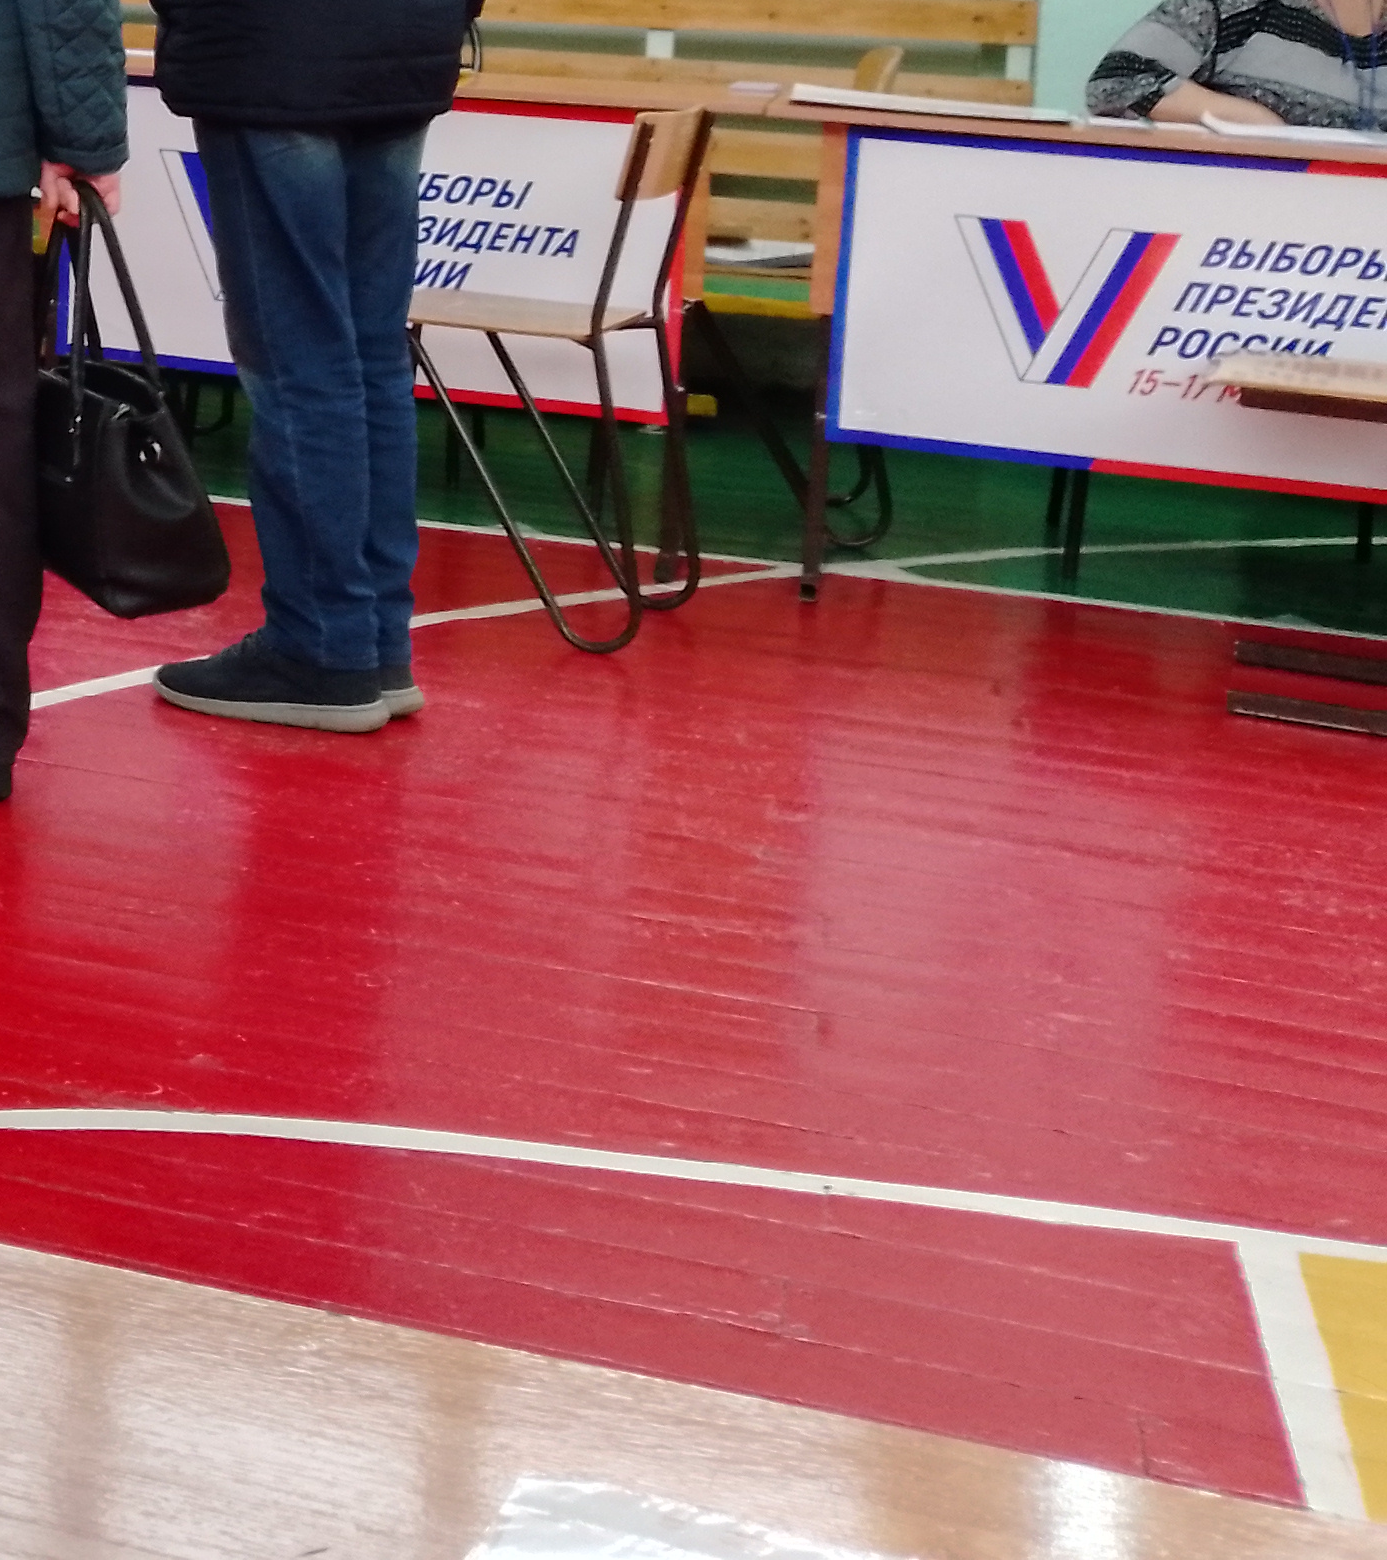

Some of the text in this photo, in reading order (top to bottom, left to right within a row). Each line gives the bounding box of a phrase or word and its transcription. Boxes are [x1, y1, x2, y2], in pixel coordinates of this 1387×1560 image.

[418, 172, 534, 211] БОРЫ
[418, 215, 580, 258] ЗИДЕНТА
[1173, 281, 1387, 331] ПРЕЗИДЕ
